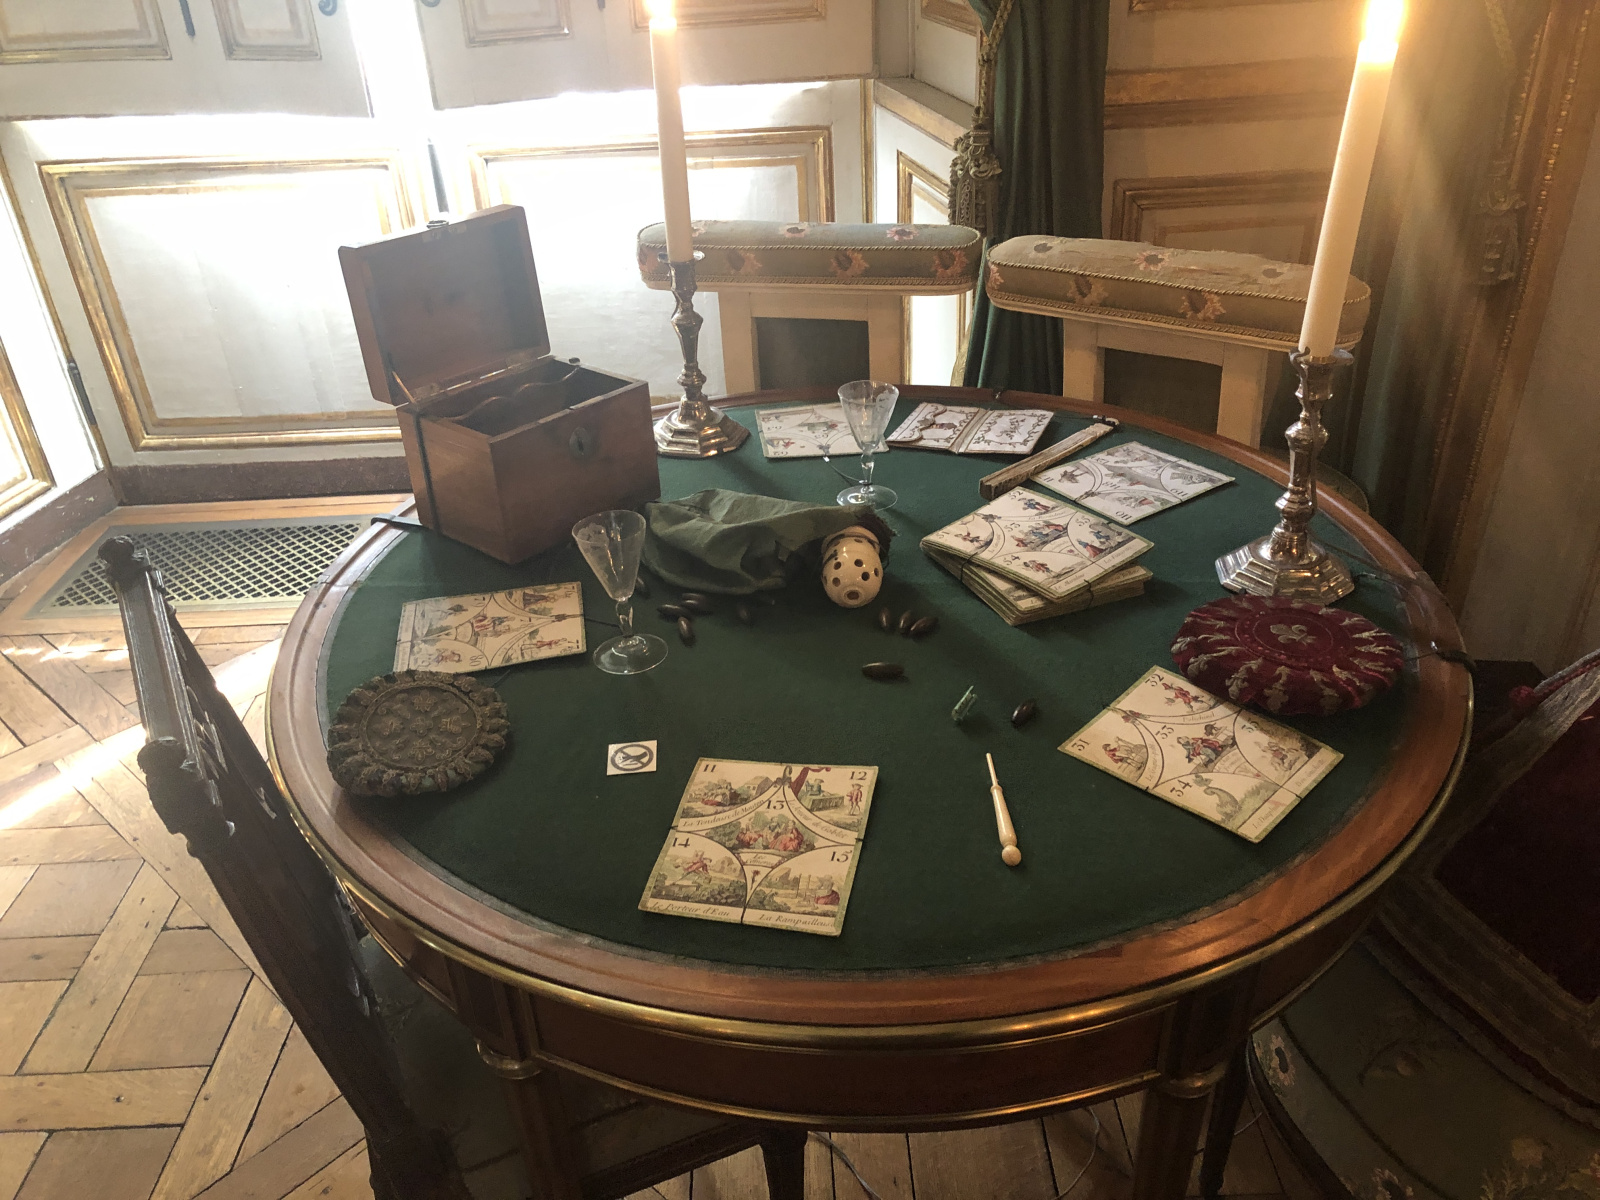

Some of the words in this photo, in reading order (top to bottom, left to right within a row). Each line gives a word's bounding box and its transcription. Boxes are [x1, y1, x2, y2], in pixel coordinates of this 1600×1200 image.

[1144, 673, 1165, 688] 32
[1154, 724, 1175, 740] 33
[1071, 738, 1090, 752] 31
[703, 763, 717, 773] 11
[849, 770, 868, 781] 12
[1169, 779, 1193, 798] 34
[765, 799, 785, 811] 13
[671, 836, 691, 848] 14
[830, 849, 853, 863] 15
[759, 914, 772, 922] La
